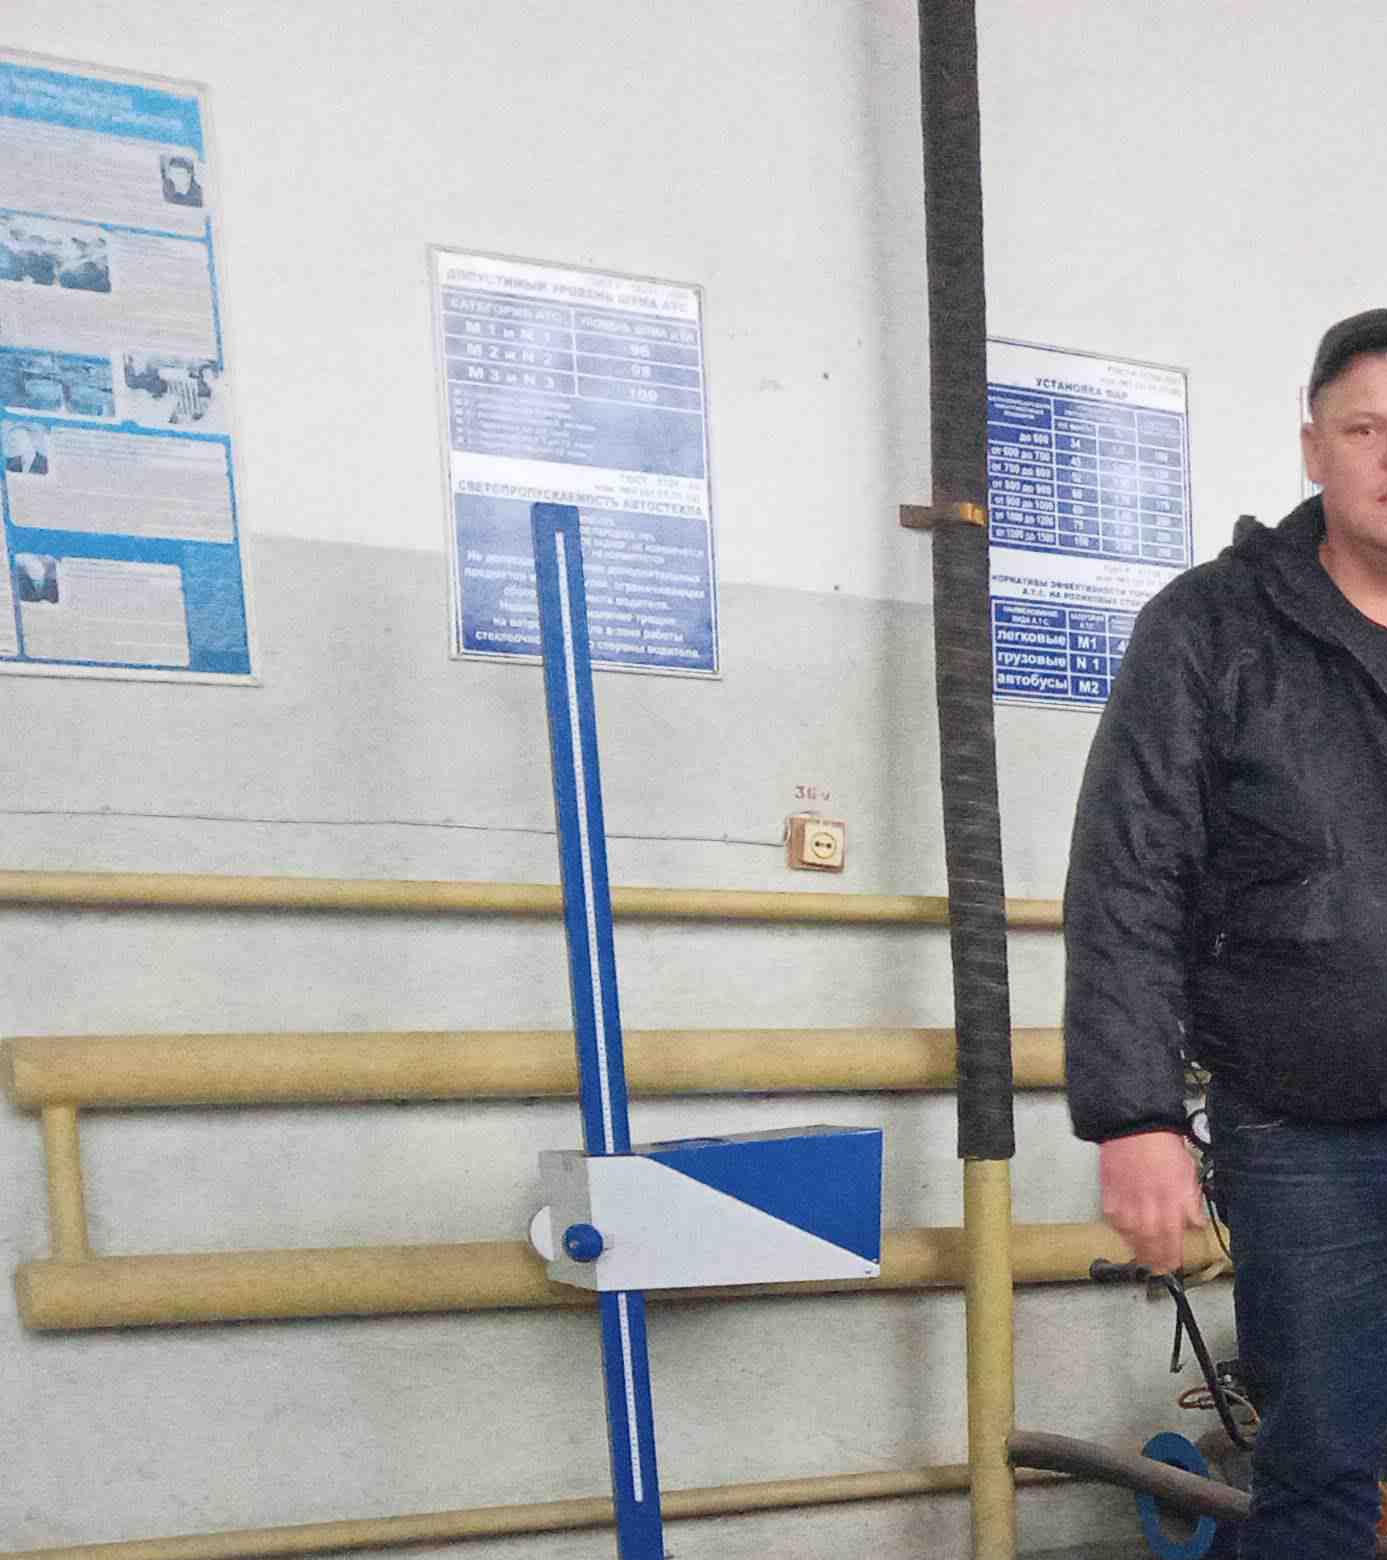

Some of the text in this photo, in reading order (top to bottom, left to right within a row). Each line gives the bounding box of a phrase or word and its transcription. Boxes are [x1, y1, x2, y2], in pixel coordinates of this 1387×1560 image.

[997, 630, 1066, 647] легковые
[1076, 636, 1097, 650] M1
[997, 651, 1066, 669] грузовые
[997, 673, 1067, 689] автобусы
[1079, 680, 1099, 694] M2
